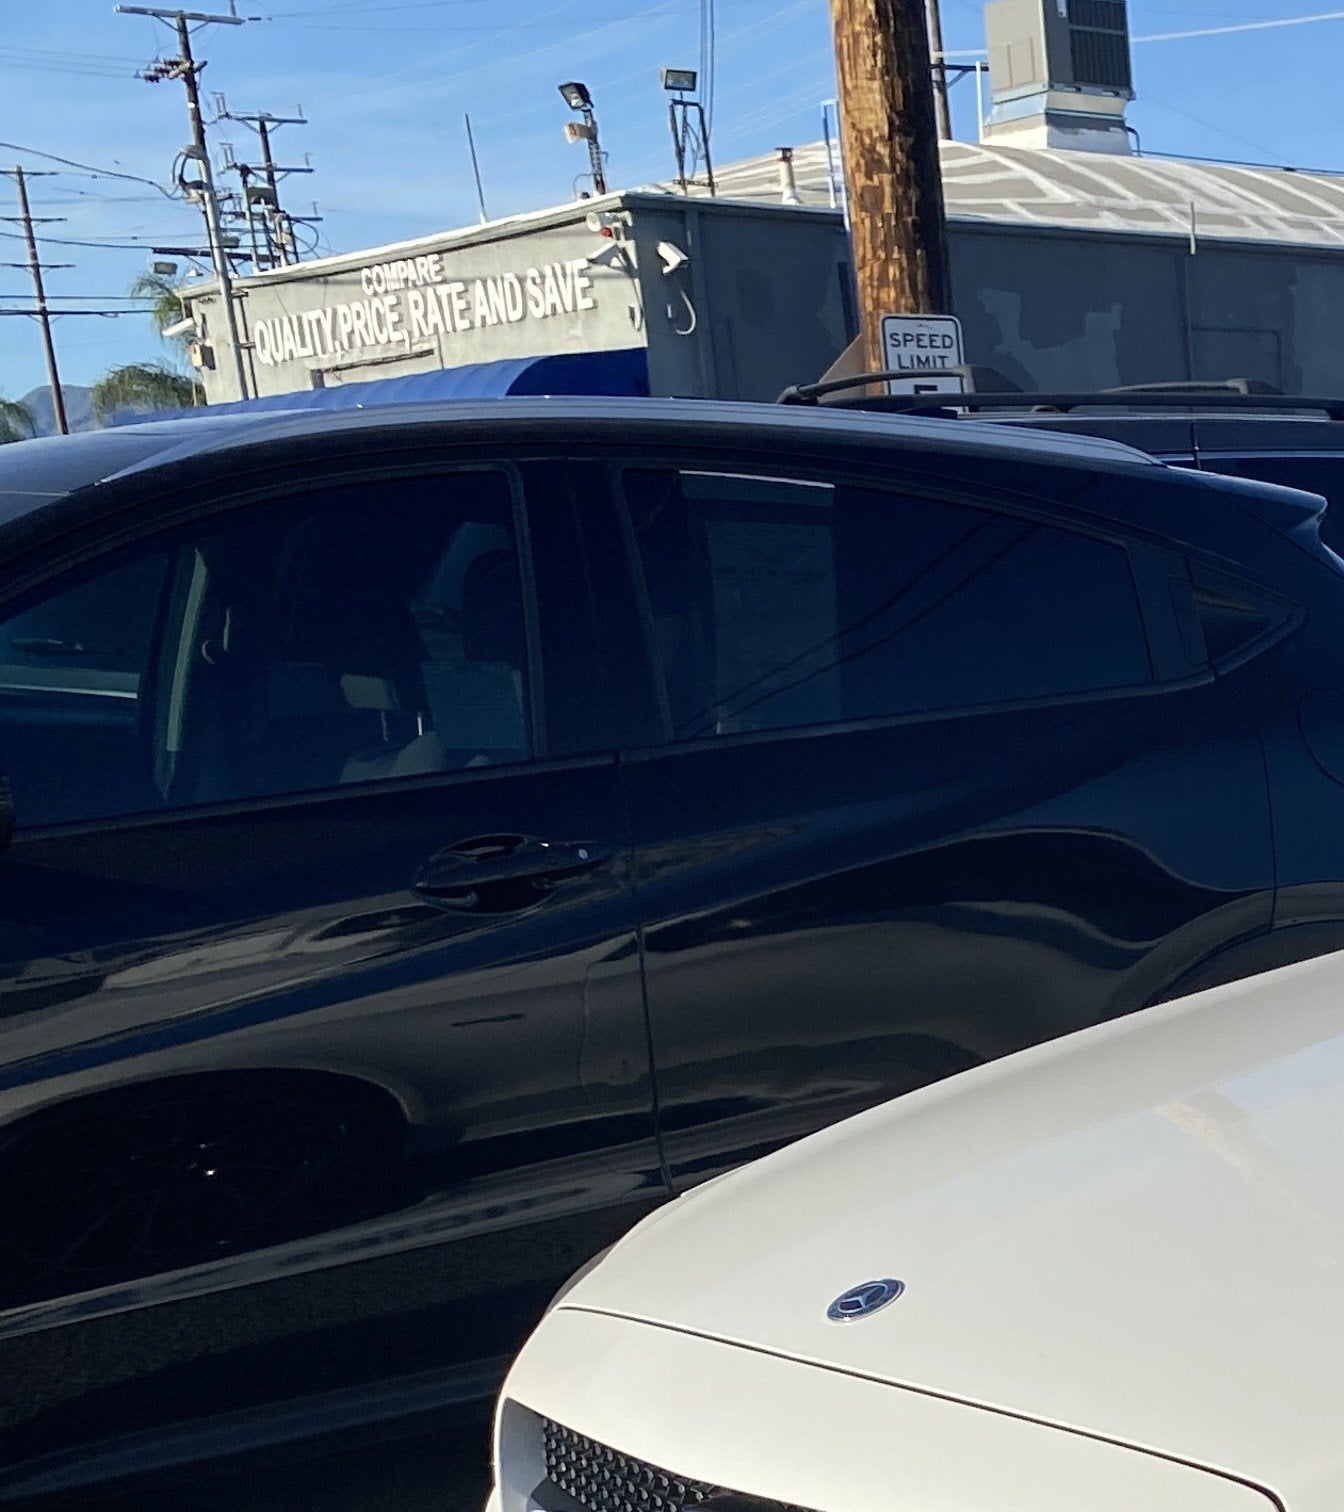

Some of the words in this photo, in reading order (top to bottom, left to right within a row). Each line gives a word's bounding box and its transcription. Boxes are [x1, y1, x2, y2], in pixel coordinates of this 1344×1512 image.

[361, 253, 443, 296] COMPARE
[407, 282, 470, 338] RATE
[475, 272, 523, 328] AND
[526, 257, 594, 319] SAVE
[889, 332, 954, 350] SPEED
[897, 354, 949, 370] LIMIT
